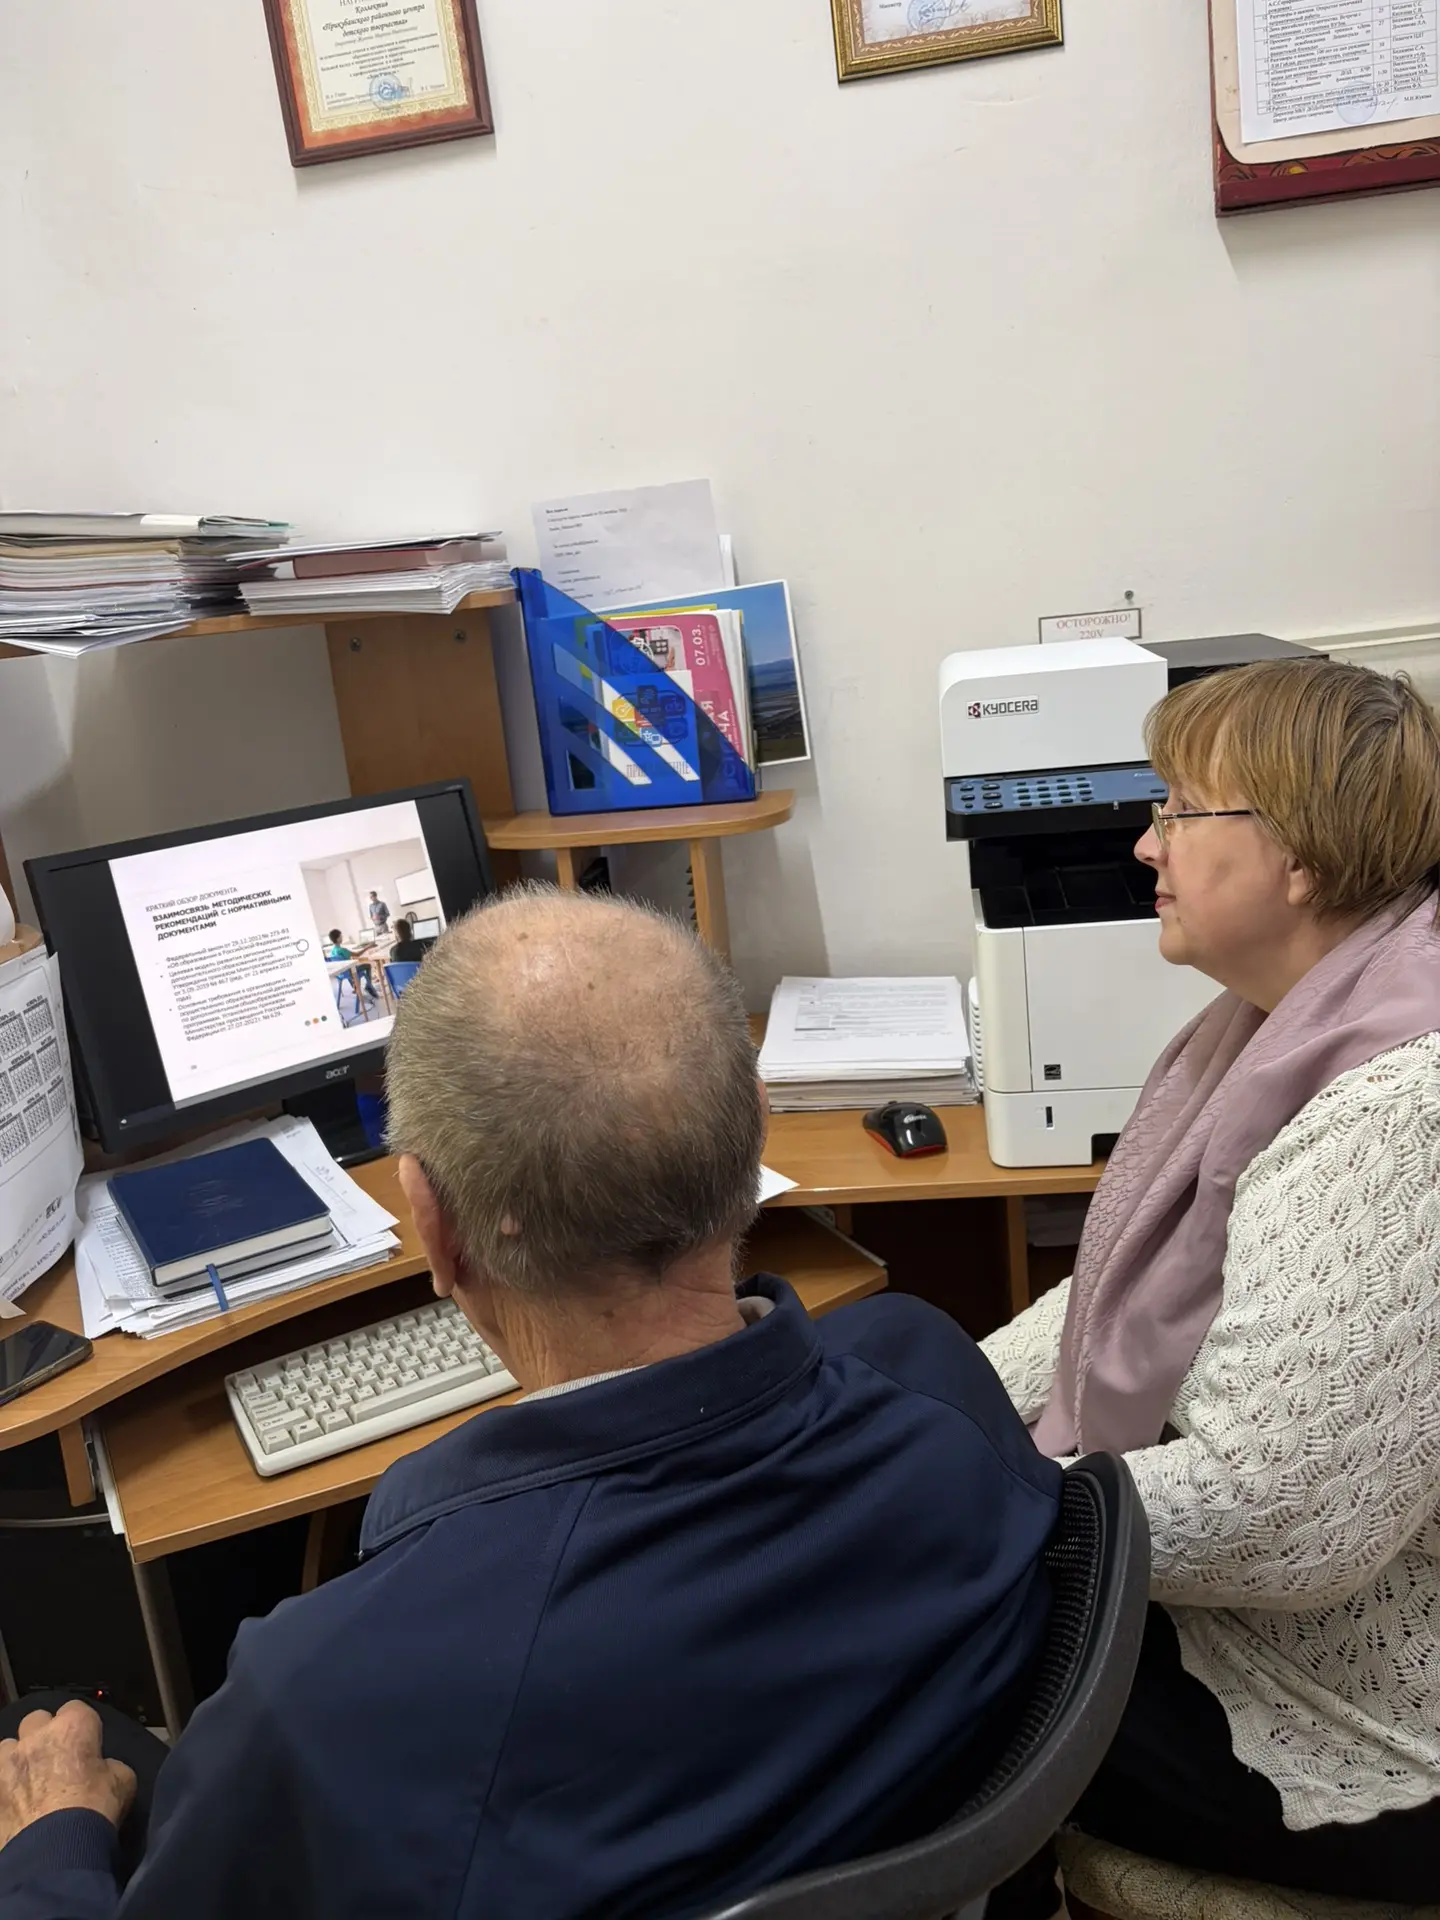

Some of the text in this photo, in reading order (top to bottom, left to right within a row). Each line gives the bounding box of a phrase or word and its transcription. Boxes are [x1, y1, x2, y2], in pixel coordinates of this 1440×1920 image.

[1056, 613, 1131, 630] ОСТОРОЖНО!
[691, 624, 706, 666] 07.03.
[983, 699, 1039, 716] KYOCERA
[146, 887, 237, 912] КРАТКИЙ ОБЗОР ДОКУМЕНТА
[153, 891, 271, 922] ВЗАИМОСВЯЗЬ МЕТОДИЧЕСКИХ
[155, 910, 218, 930] РЕКОМЕНДАЦИЙ
[228, 895, 291, 913] НОРМАТИВНЫМИ
[158, 922, 216, 940] ДОКУМЕНТАМИ
[325, 1065, 350, 1080] acer
